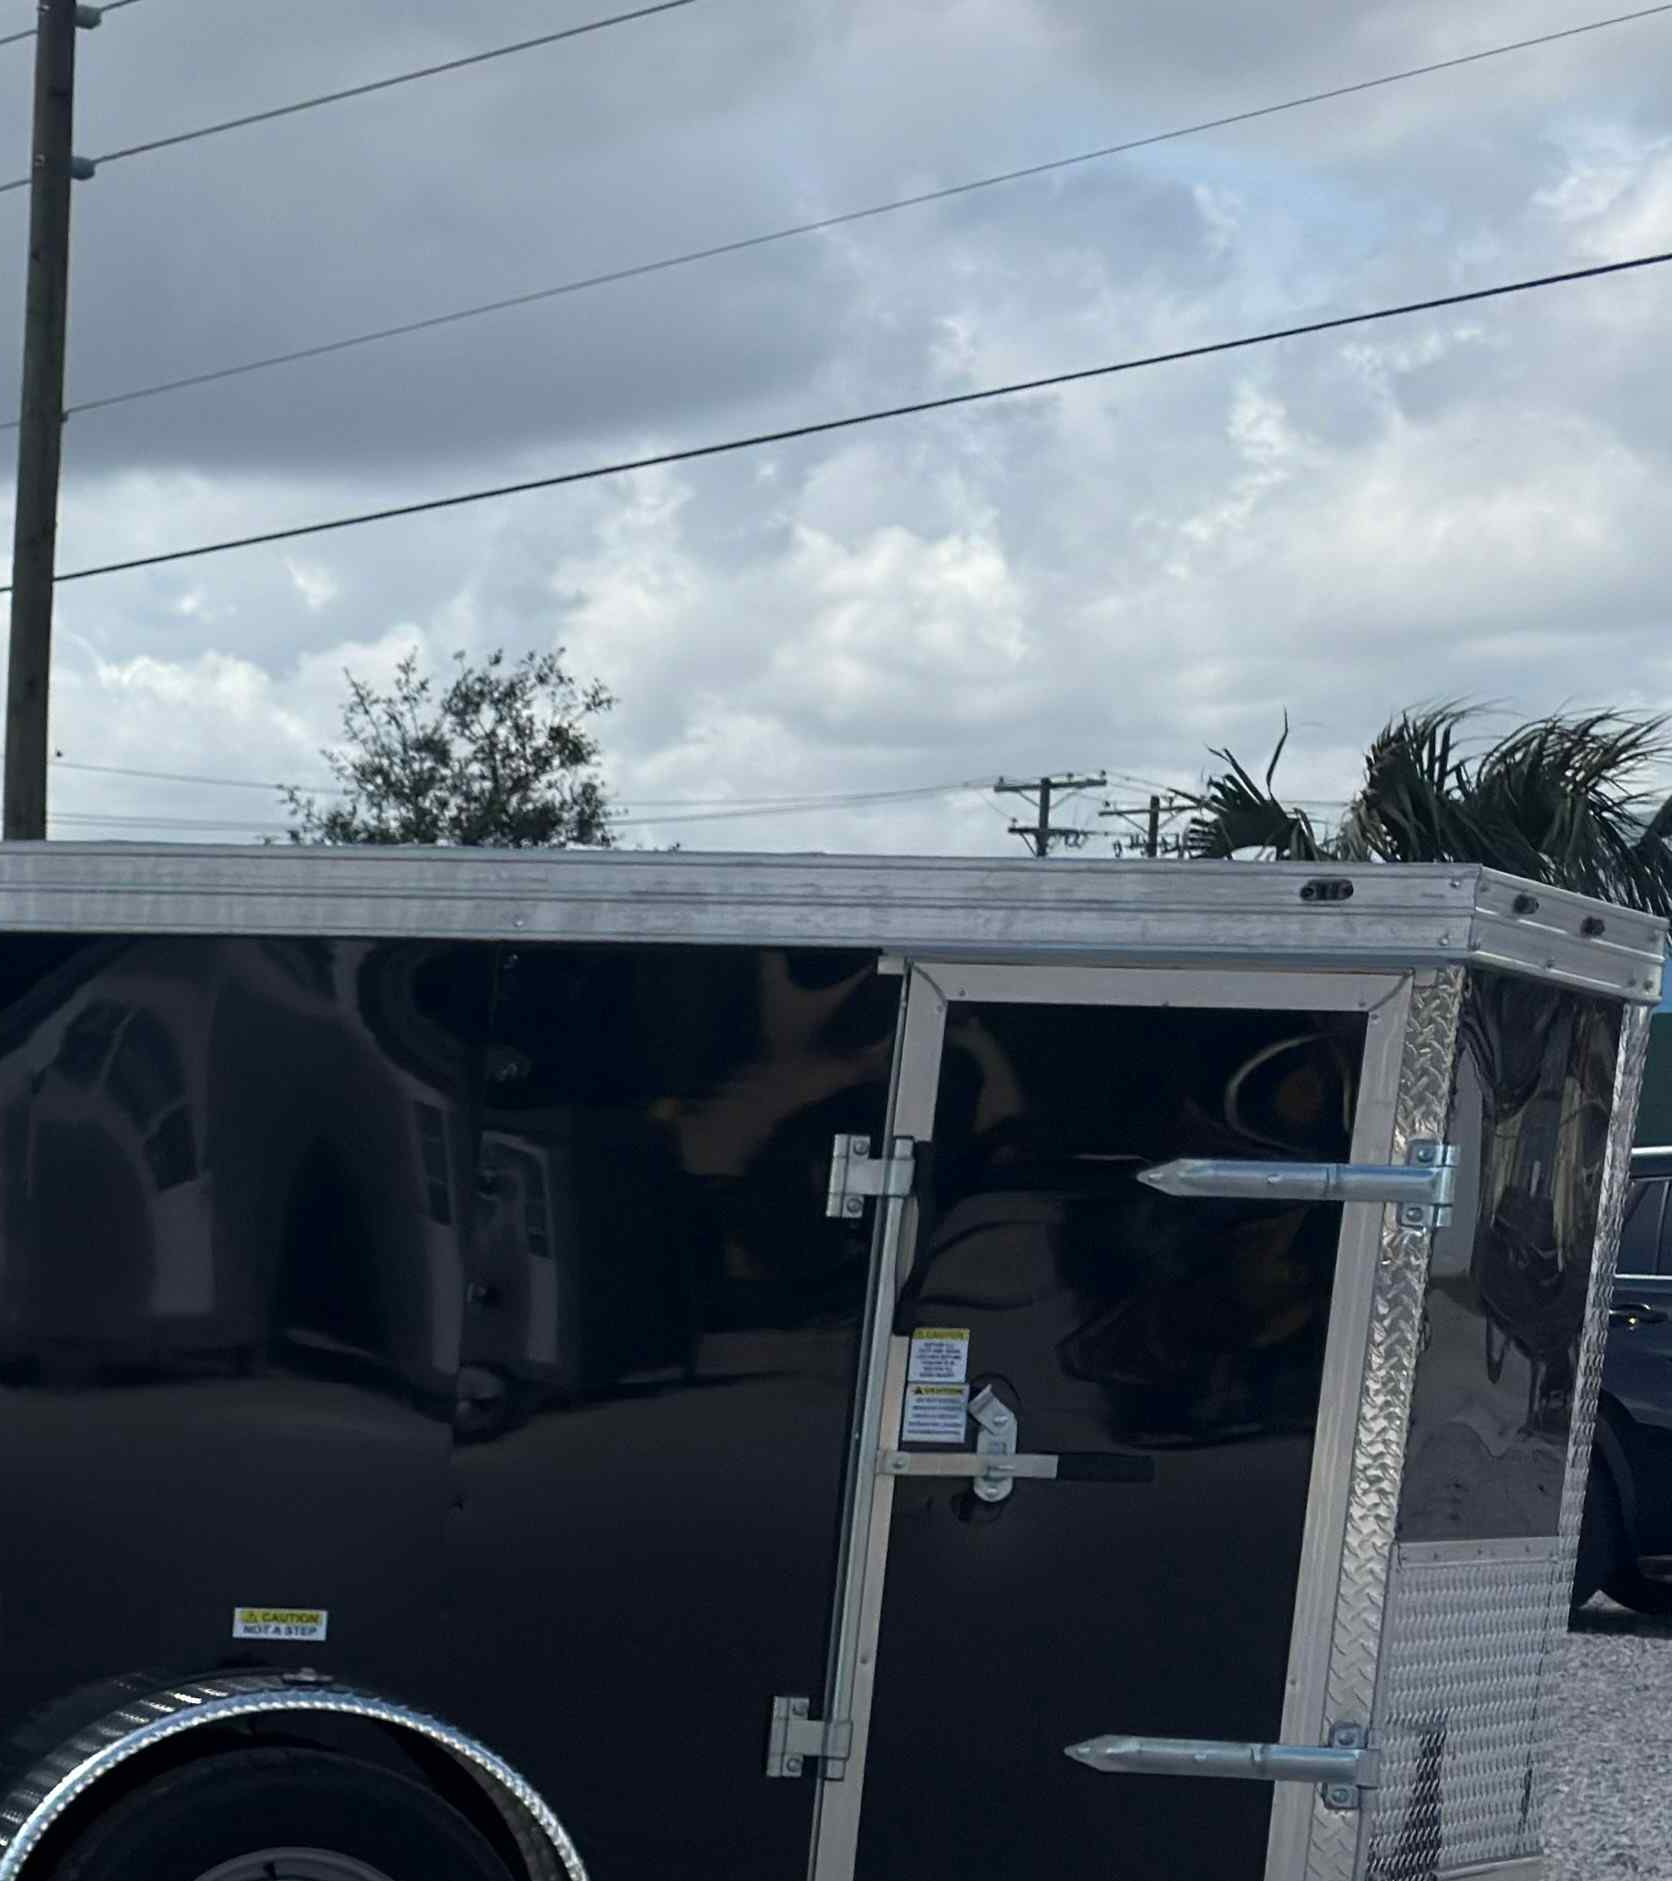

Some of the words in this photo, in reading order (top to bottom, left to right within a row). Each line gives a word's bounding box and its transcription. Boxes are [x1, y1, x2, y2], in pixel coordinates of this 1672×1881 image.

[263, 1611, 319, 1623] CAUTION
[243, 1624, 270, 1633] NOT
[273, 1626, 281, 1635] A
[285, 1626, 317, 1636] STEP
